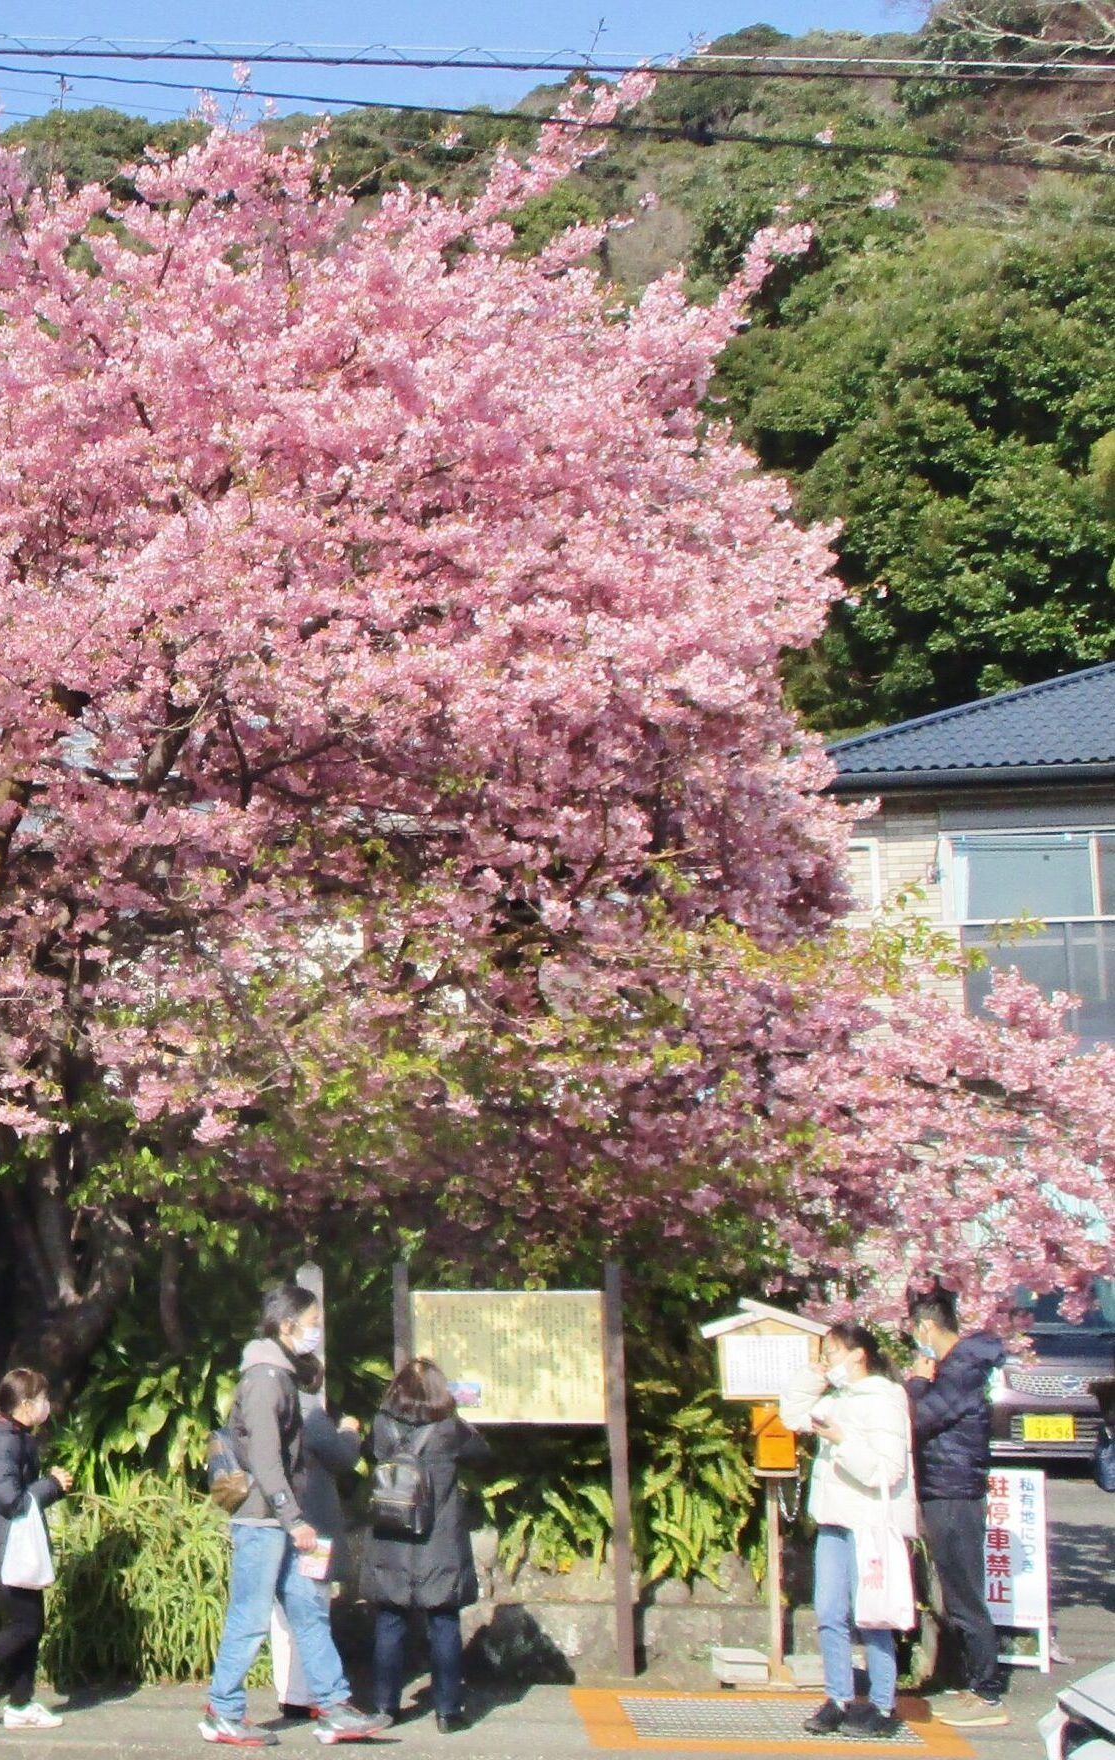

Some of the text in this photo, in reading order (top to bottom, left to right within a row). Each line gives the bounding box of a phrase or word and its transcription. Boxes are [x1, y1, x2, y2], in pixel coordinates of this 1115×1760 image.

[986, 1476, 1012, 1604] 駐停車禁止
[1019, 1477, 1036, 1574] 私有地につき
